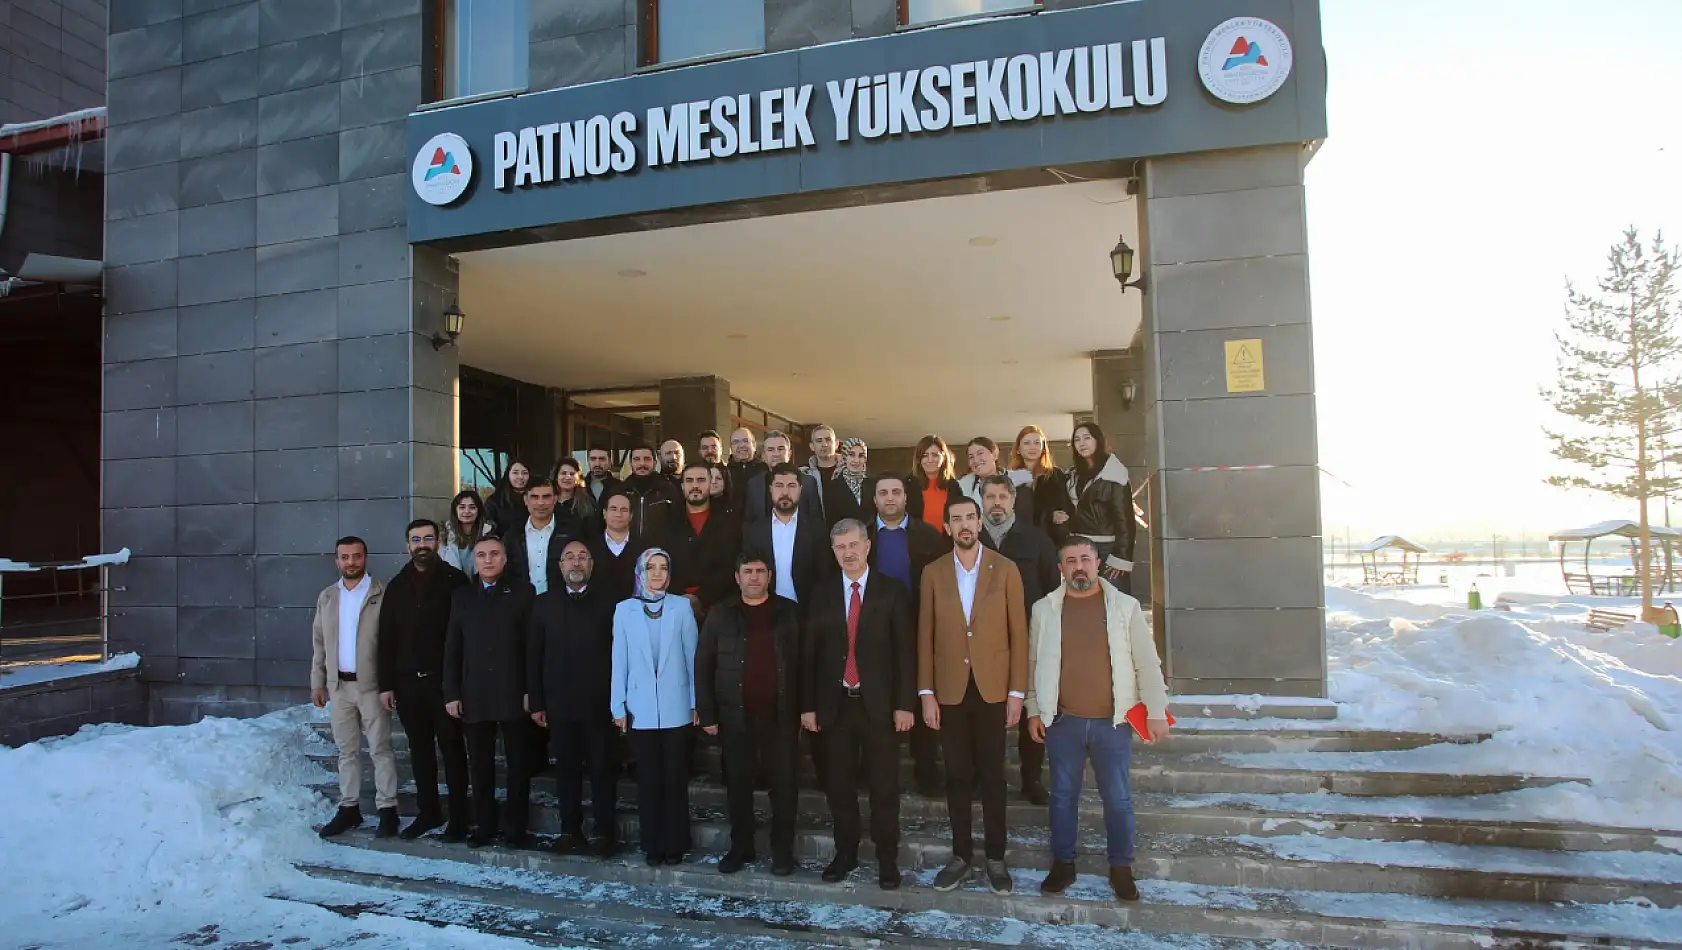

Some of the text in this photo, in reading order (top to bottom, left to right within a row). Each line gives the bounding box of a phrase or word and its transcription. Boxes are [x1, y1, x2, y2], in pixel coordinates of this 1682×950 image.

[494, 37, 1168, 190] PATNOS MESLEK YÜKSEKOKULU
